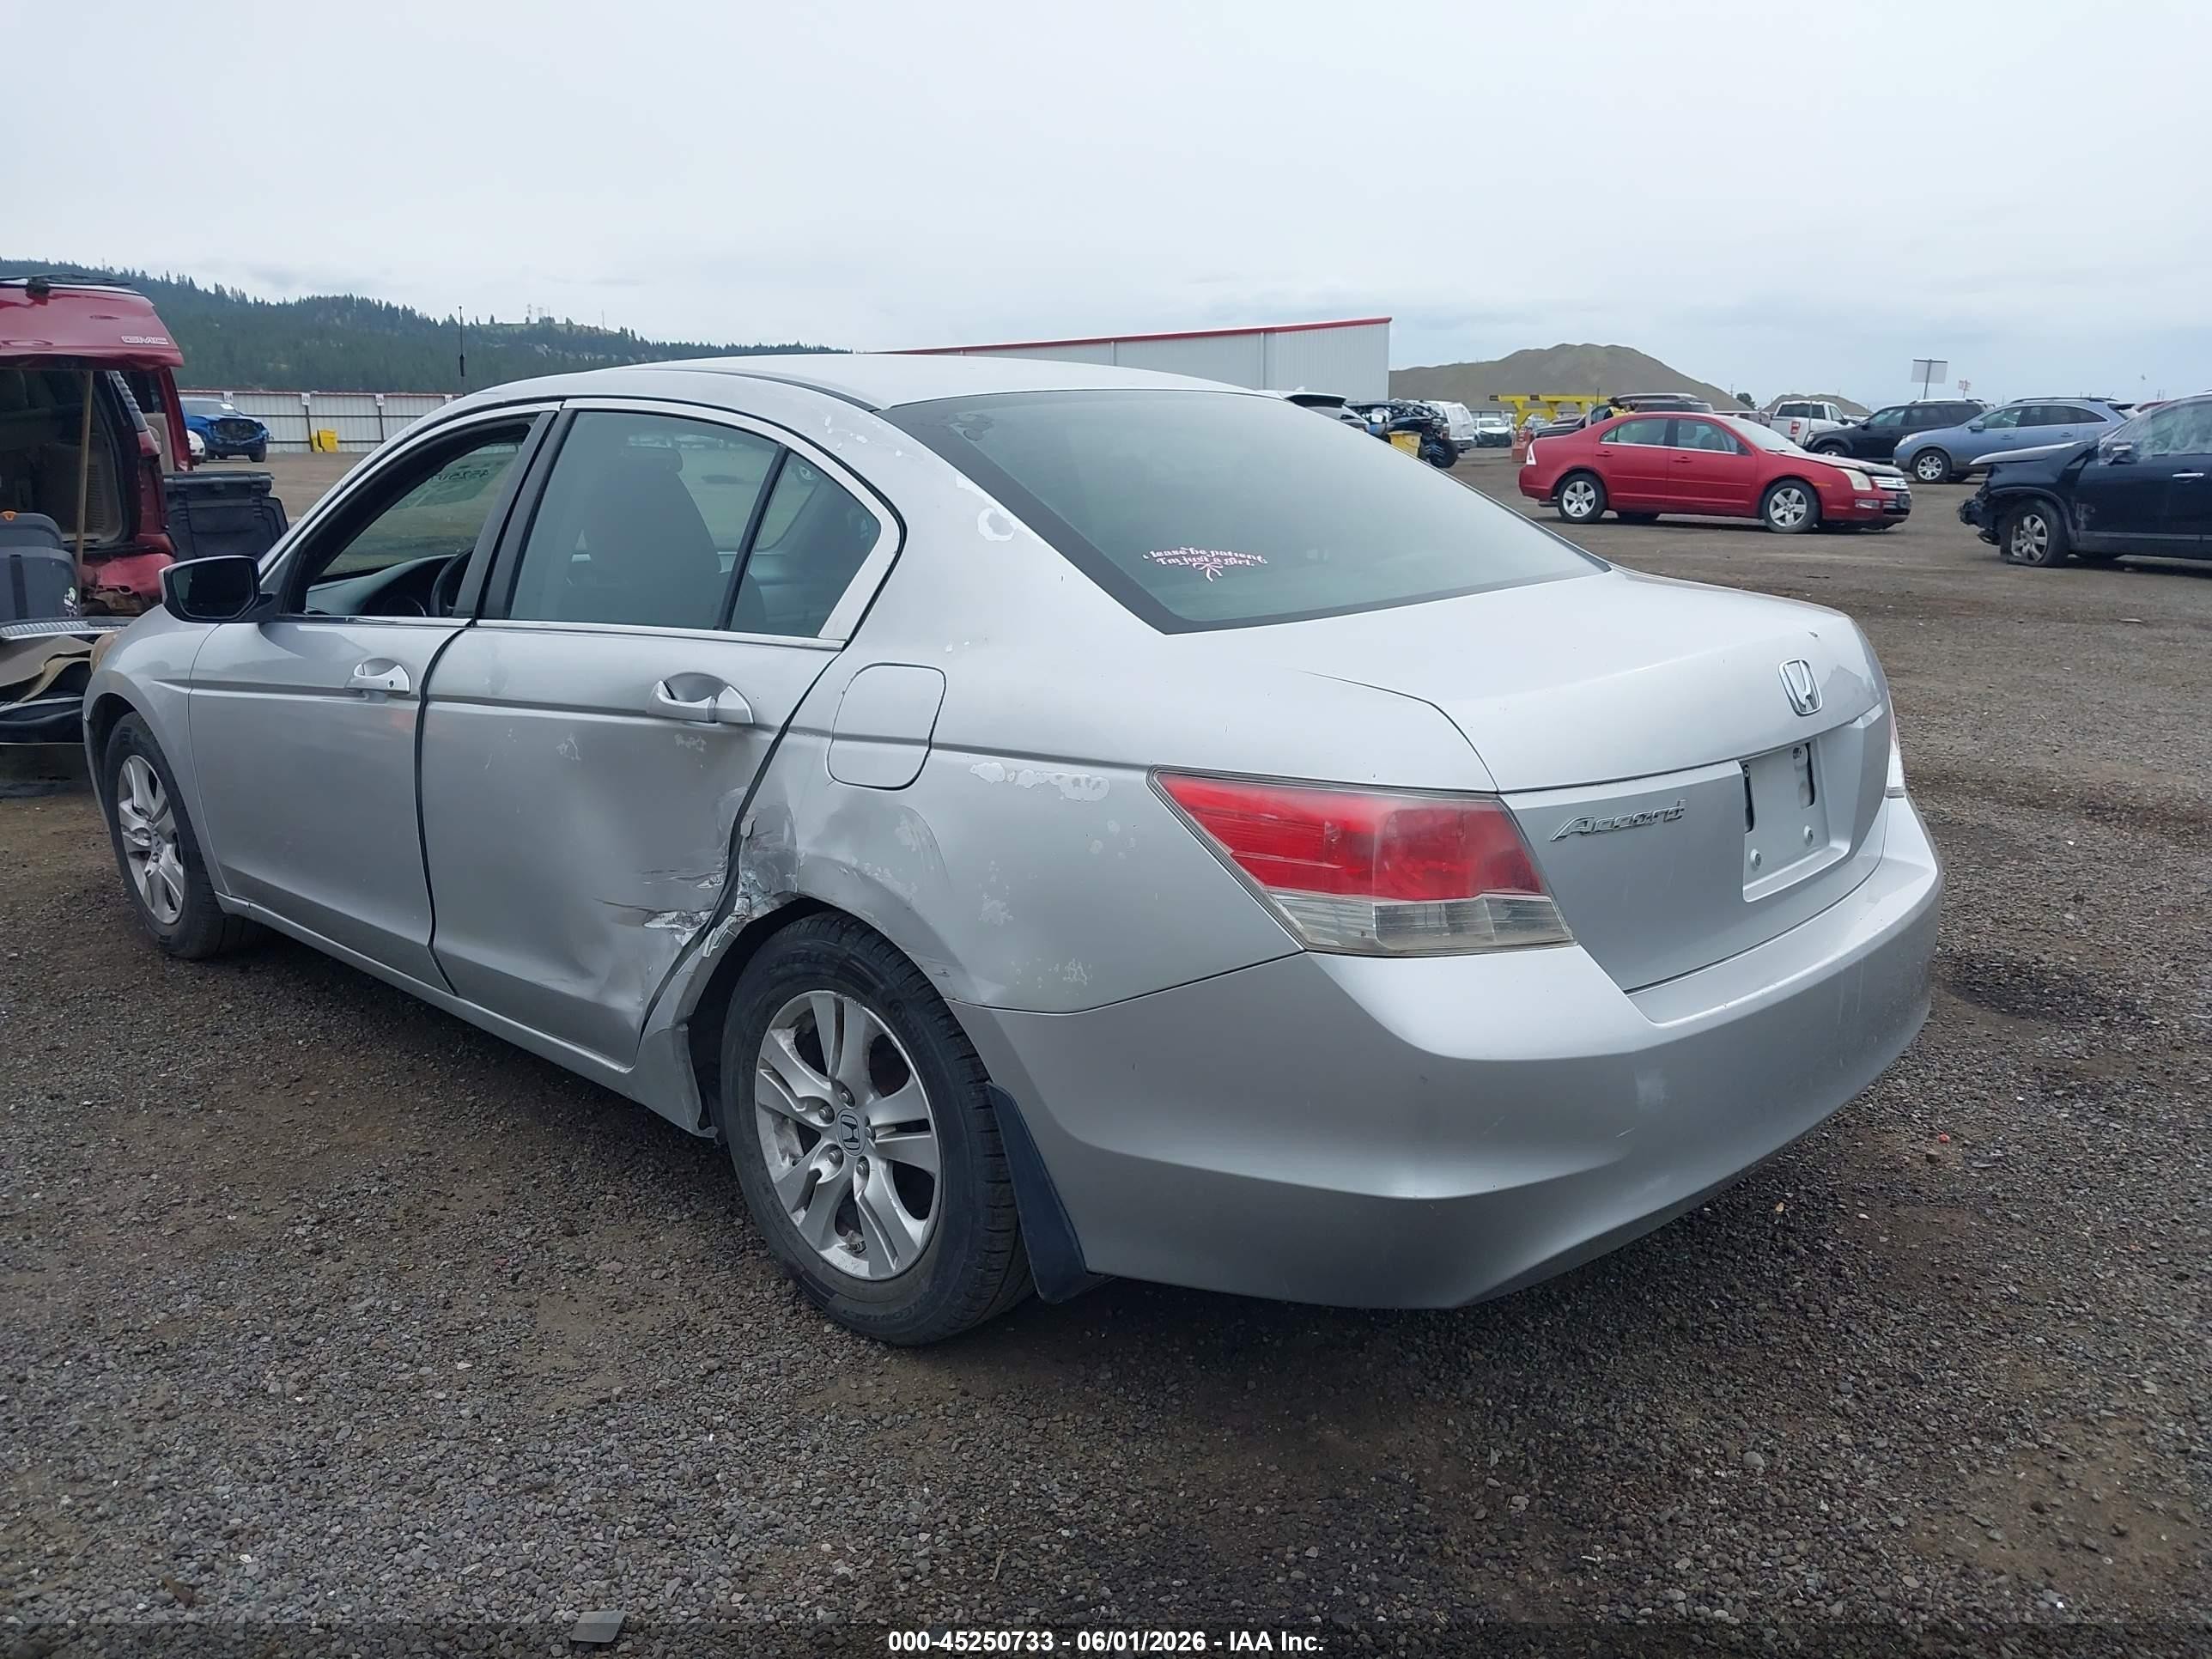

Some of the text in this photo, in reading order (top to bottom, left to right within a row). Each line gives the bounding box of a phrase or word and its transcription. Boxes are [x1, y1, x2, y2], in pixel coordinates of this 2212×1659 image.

[121, 335, 169, 345] GMC
[1142, 547, 1188, 560] lease
[1188, 547, 1207, 556] be
[1178, 556, 1210, 566] just
[1549, 798, 1686, 842] Accord
